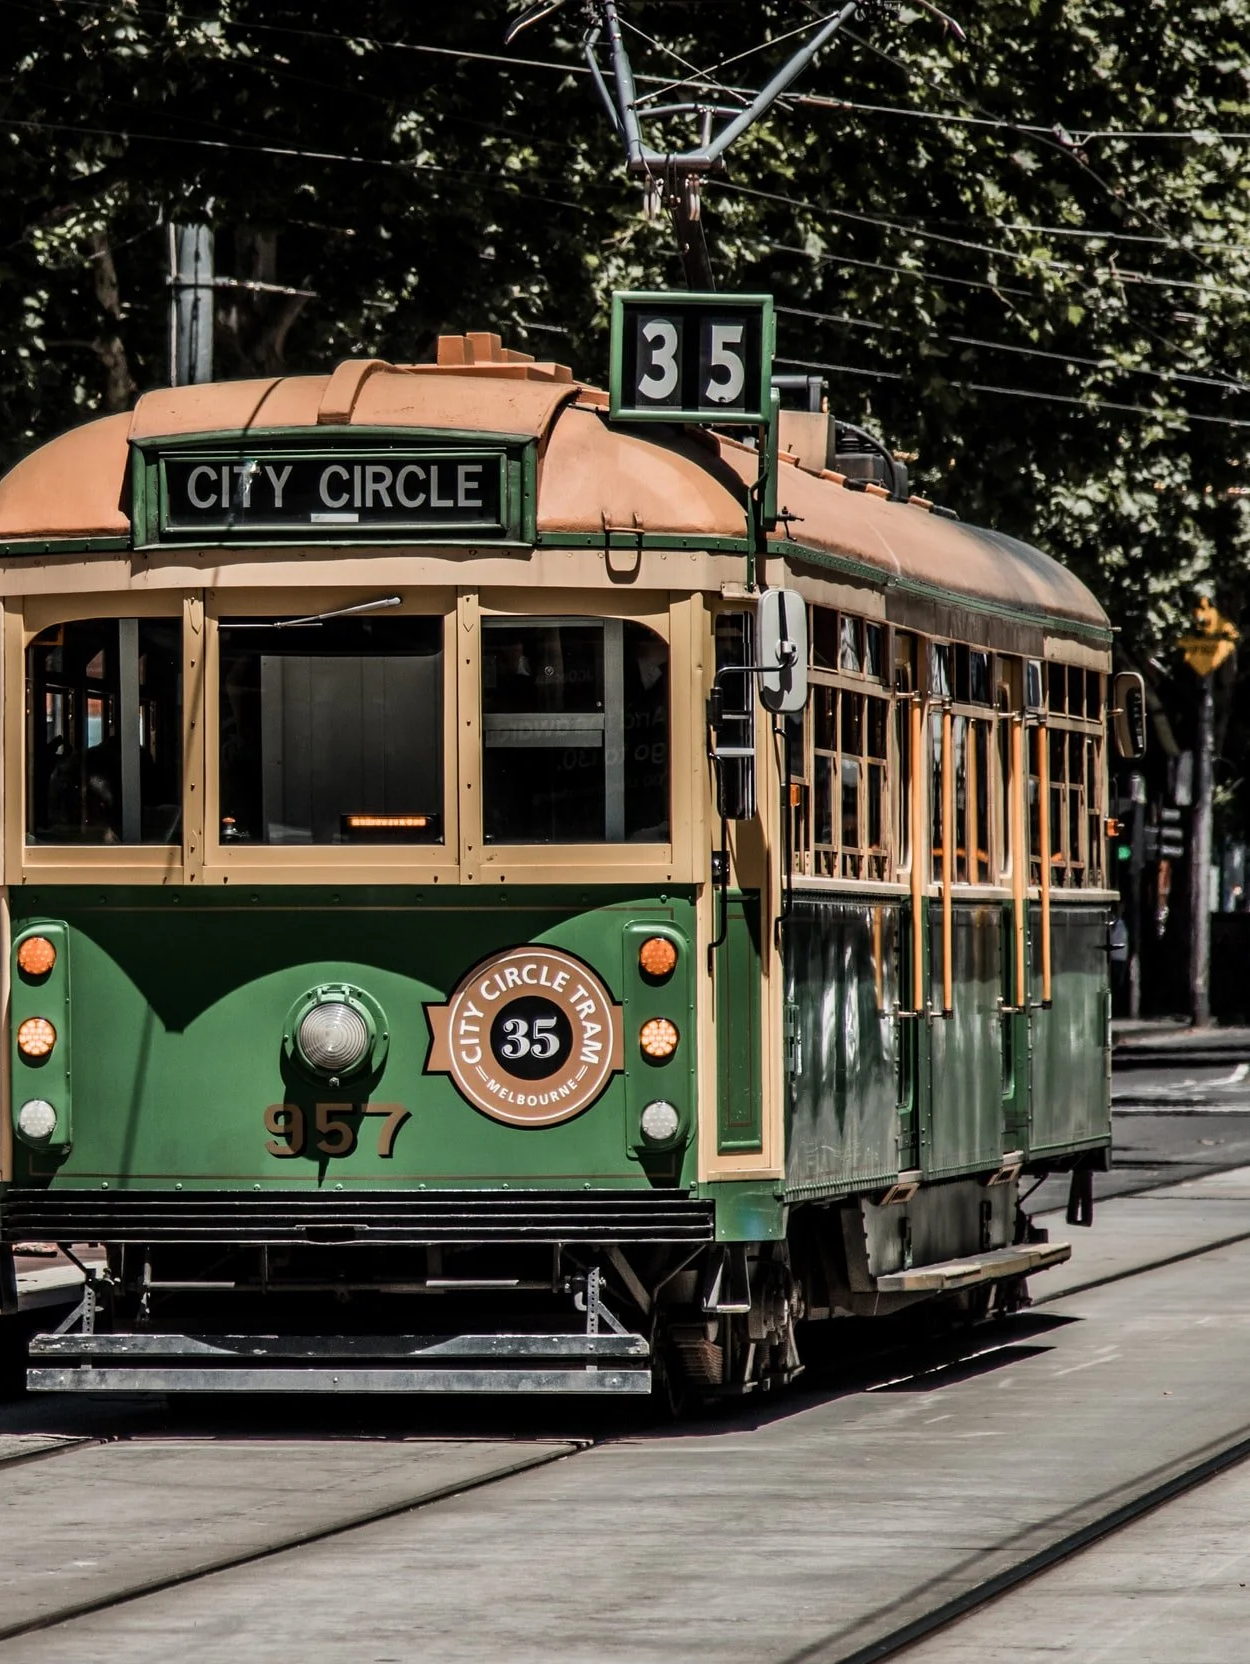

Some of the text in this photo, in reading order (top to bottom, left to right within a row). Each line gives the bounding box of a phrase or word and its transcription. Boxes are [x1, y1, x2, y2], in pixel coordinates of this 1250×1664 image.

[187, 464, 483, 509] CITY CIRCLE
[460, 964, 603, 1065] CITY CIRCLE TRAM
[501, 1016, 560, 1059] 35
[486, 1079, 578, 1106] MELBOURNE
[263, 1103, 412, 1157] 957
